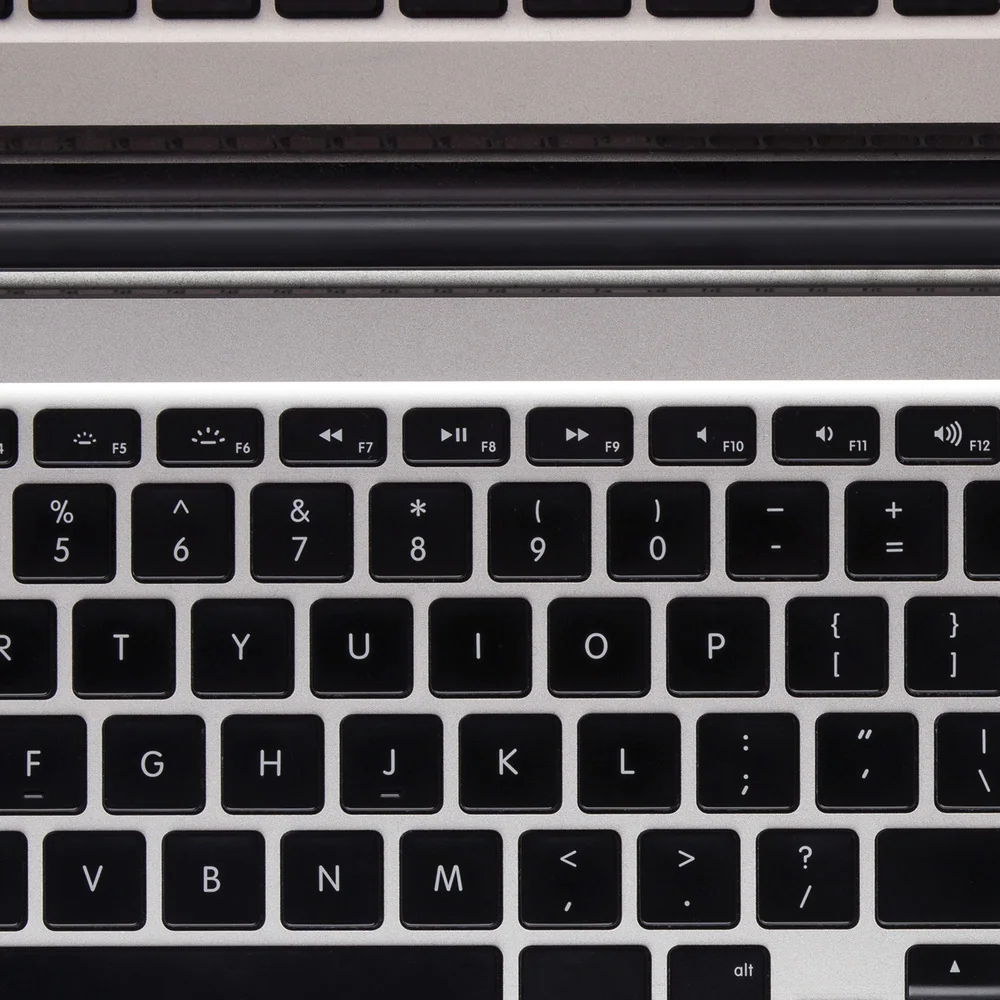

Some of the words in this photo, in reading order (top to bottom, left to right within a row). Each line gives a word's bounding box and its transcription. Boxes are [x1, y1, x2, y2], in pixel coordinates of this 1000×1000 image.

[112, 442, 127, 455] F5
[235, 442, 251, 454] F6
[358, 441, 374, 454] F7
[481, 440, 497, 453] F8
[605, 440, 620, 453] F9
[723, 440, 745, 453] F10
[849, 439, 867, 452] F11
[969, 439, 991, 452] F12
[50, 499, 74, 524] %
[290, 498, 310, 523] &
[885, 501, 903, 519] +
[53, 537, 70, 563] 5
[173, 536, 190, 562] 6
[291, 536, 308, 562] 7
[410, 536, 427, 562] 8
[530, 536, 546, 562] 9
[649, 535, 667, 561] 0
[885, 541, 904, 553] =
[830, 612, 841, 639] {
[949, 612, 959, 639] }
[0, 634, 12, 661] R
[112, 633, 130, 661] T
[231, 633, 251, 661] Y
[348, 632, 370, 660] U
[584, 632, 609, 660] O
[707, 632, 726, 660] P
[833, 651, 840, 678] [
[950, 651, 957, 678] ]
[26, 750, 42, 777] F
[140, 750, 164, 778] G
[259, 749, 282, 777] H
[382, 748, 396, 776] J
[498, 748, 519, 776] K
[620, 747, 636, 775] L
[741, 773, 749, 796] ;
[559, 850, 577, 868] <
[678, 850, 696, 868] >
[798, 845, 813, 870] ?
[82, 864, 104, 892] V
[203, 865, 221, 893] B
[318, 864, 340, 892] N
[433, 864, 463, 892] M
[799, 884, 812, 909] /
[733, 962, 754, 977] alt
